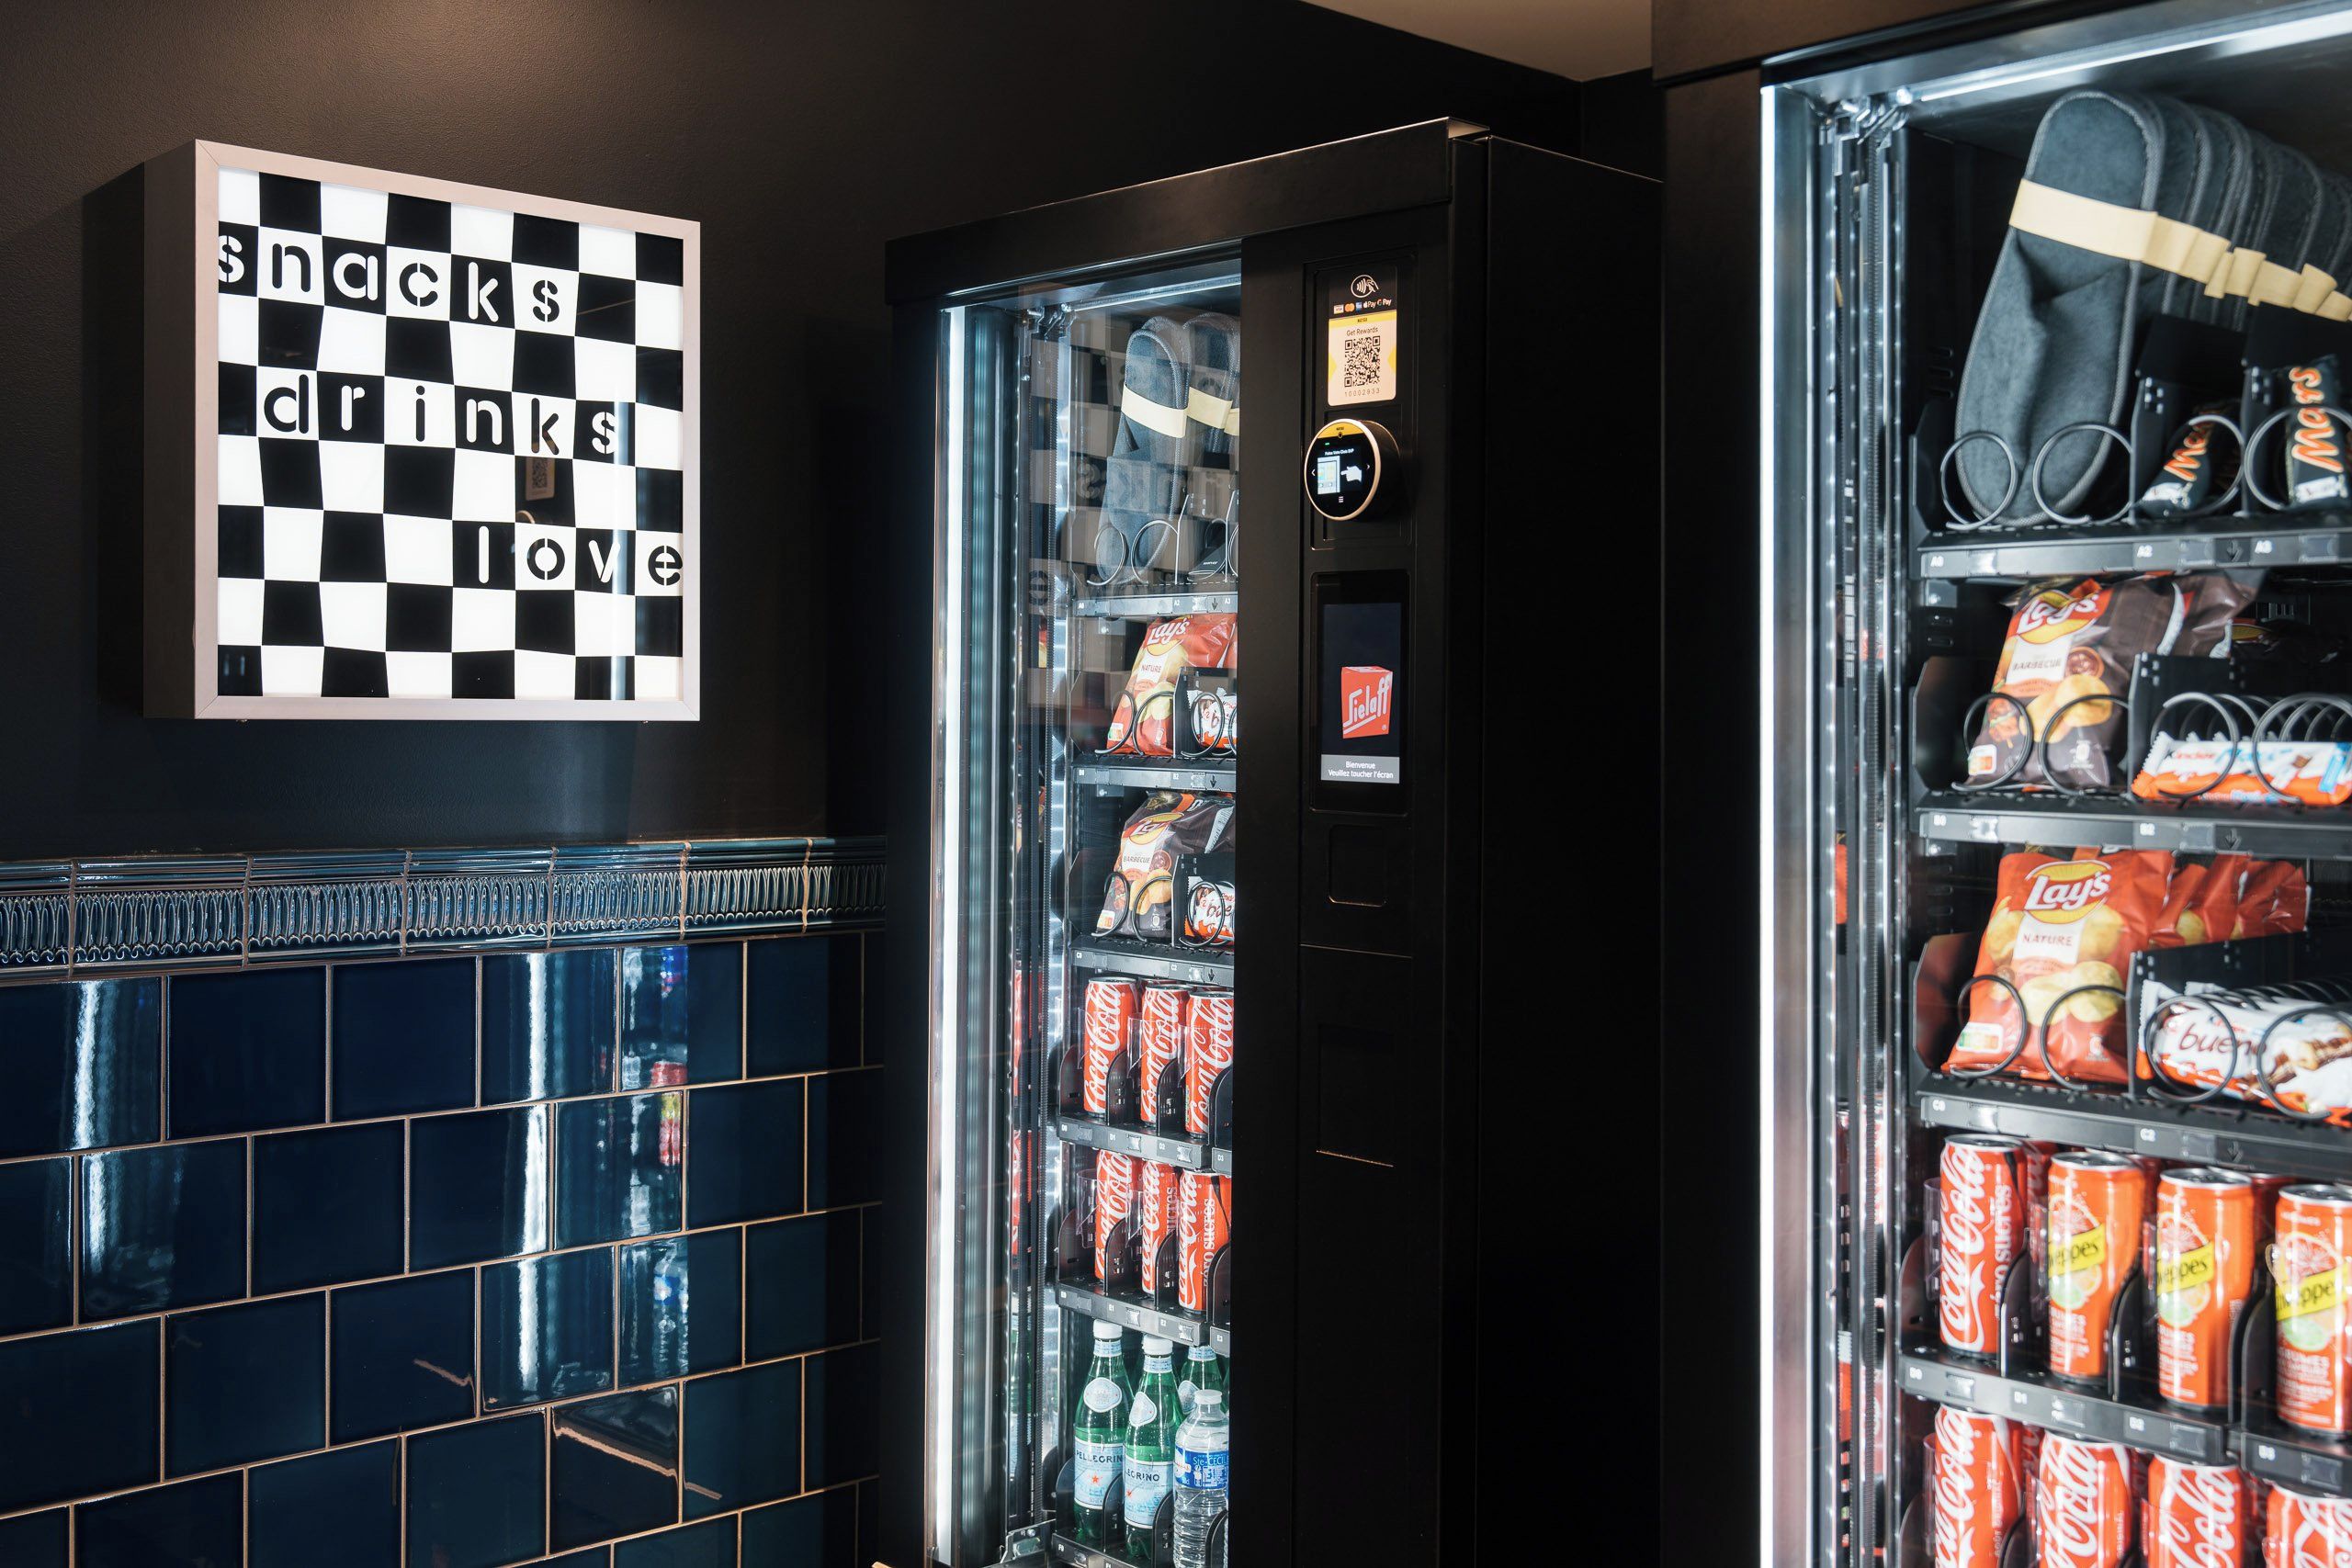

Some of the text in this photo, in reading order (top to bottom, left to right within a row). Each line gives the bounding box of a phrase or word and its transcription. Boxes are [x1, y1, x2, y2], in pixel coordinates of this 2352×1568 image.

[218, 234, 560, 322] snacks
[1356, 326, 1378, 334] Rewards
[263, 374, 619, 456] drinks
[2289, 367, 2344, 473] Mars
[479, 525, 683, 586] love
[1147, 617, 1190, 644] Lay's
[1141, 664, 1162, 674] NATURE
[1328, 769, 1350, 777] Veuillez
[1351, 770, 1373, 778] toucher
[1345, 761, 1376, 770] Bienvenue
[1123, 854, 1151, 864] BARBECUE
[2024, 871, 2112, 911] Lay's
[2022, 933, 2075, 947] NATURE
[1203, 1197, 1216, 1249] sucres
[1994, 1183, 2013, 1263] sucres
[1939, 1142, 1985, 1351] Coca-Cola
[1076, 1450, 1123, 1463] PELLEGRIN
